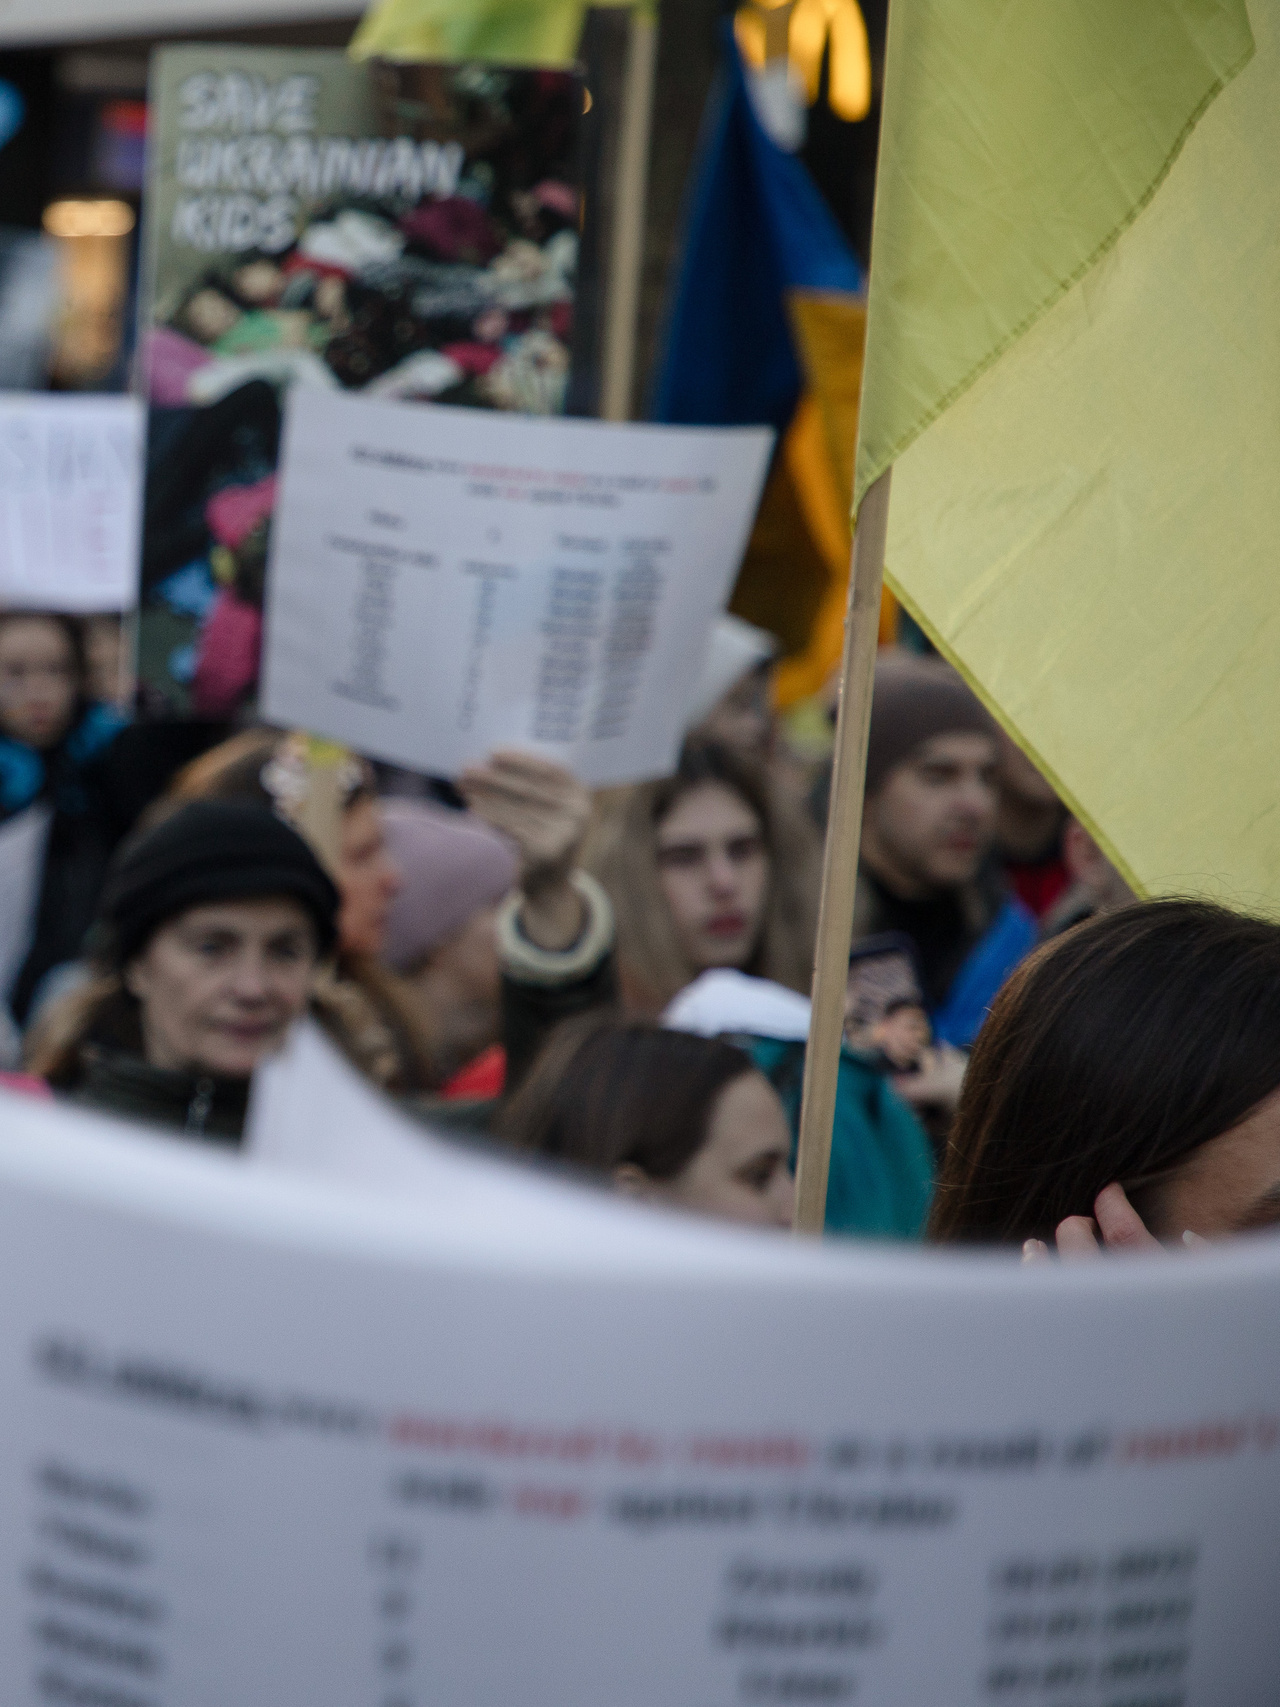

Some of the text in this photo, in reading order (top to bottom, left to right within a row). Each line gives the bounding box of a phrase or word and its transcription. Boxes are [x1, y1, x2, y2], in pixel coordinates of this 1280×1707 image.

[178, 70, 320, 131] SAVE
[176, 136, 466, 198] UKRAINIAN
[172, 193, 297, 253] KIDS
